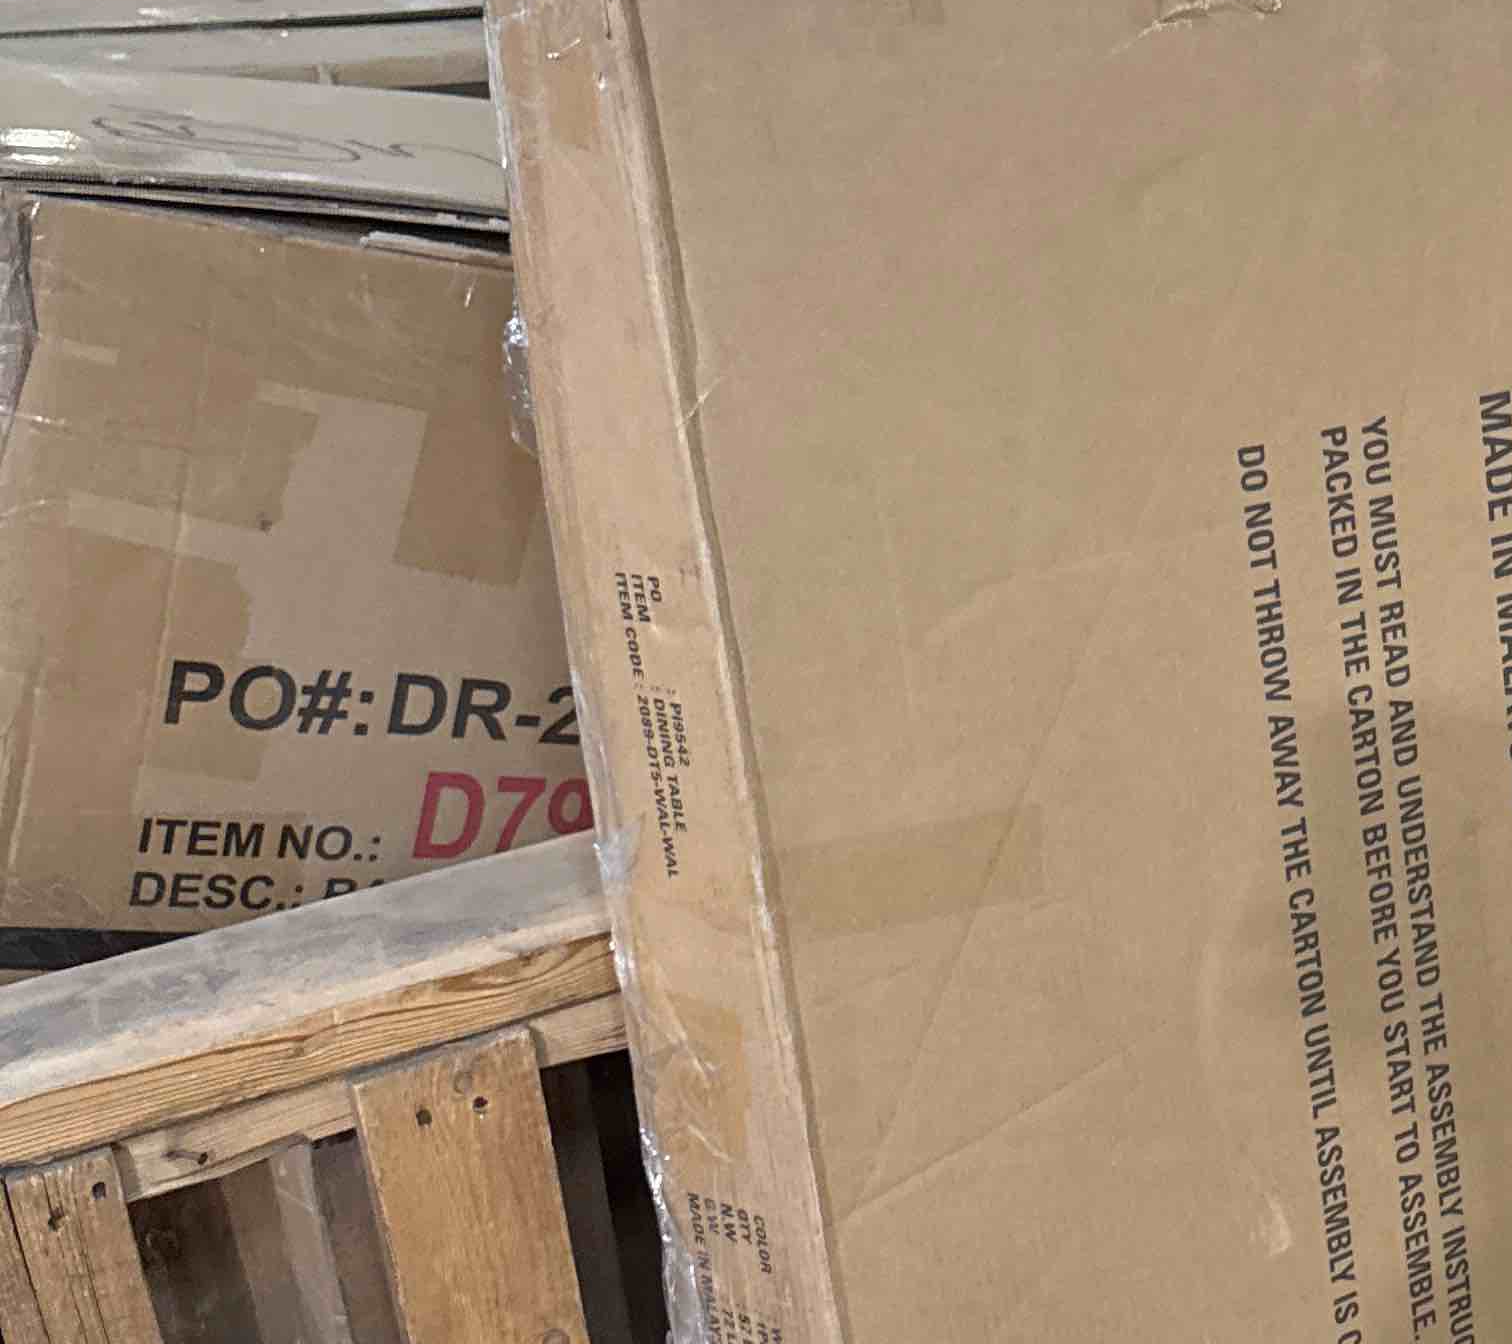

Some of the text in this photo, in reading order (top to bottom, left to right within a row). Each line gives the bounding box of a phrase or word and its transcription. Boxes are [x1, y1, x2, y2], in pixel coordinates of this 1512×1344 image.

[1237, 444, 1269, 493] DO
[1360, 416, 1392, 487] YOU
[1244, 502, 1278, 572] NOT
[1369, 495, 1402, 591] MUST
[615, 571, 634, 621] ITEM
[625, 626, 645, 679] CODE
[647, 575, 663, 604] PO
[1253, 579, 1293, 703] THROW
[1378, 599, 1412, 689] READ
[163, 659, 374, 737] PO#:
[631, 573, 688, 833] ITEM DINING TABLE
[1388, 699, 1418, 770] AND
[1267, 714, 1304, 809] AWAY
[137, 817, 267, 858] ITEM
[277, 823, 382, 862] NO.:
[1281, 817, 1312, 883] THE
[128, 871, 304, 911] DESC.:
[1320, 425, 1438, 1342] PACKED IN THE CARTON BEFORE YOU START TO ASSEMBLE.
[1396, 776, 1440, 988] UNDERSTAND
[1288, 889, 1327, 1019] CARTON
[1419, 994, 1448, 1056] THE
[1303, 1022, 1337, 1119] UNTIL
[1425, 1062, 1463, 1217] ASSEMBLY
[687, 1192, 706, 1246] MADE
[697, 1250, 712, 1271] IN
[737, 1207, 753, 1245] QTY
[1313, 1126, 1360, 1284] ASSEMBLY
[753, 1214, 772, 1275] COLOR
[737, 1312, 753, 1336] 57
[1333, 1290, 1361, 1327] IS
